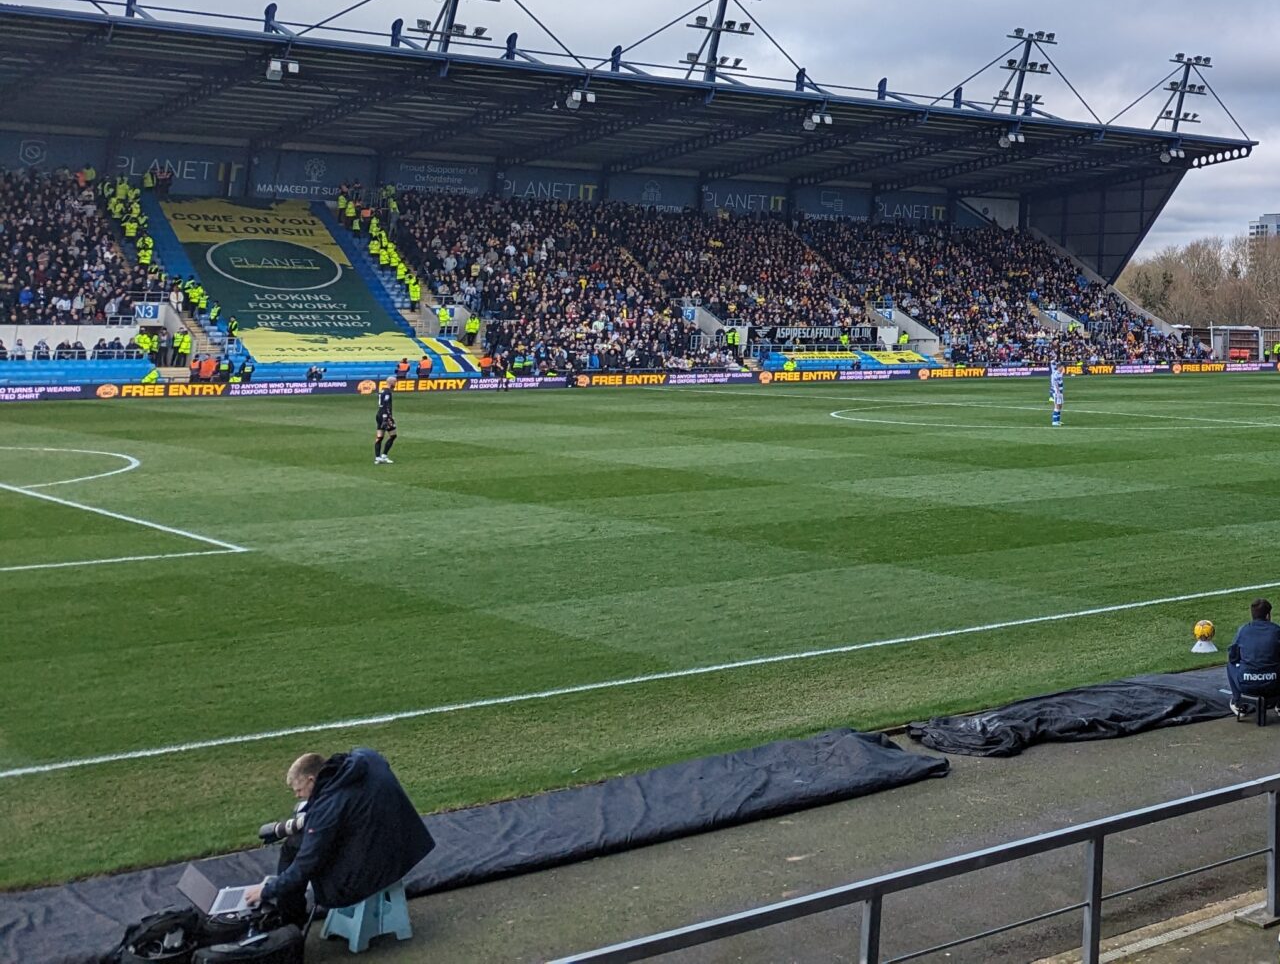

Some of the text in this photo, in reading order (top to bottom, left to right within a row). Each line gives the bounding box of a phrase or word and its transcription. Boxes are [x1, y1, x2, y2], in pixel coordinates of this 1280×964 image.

[256, 184, 308, 194] MANAGED
[310, 186, 319, 194] IT
[504, 180, 598, 201] PLANET IT
[704, 192, 786, 211] PLANET IT
[878, 202, 928, 220] PLANET
[932, 206, 946, 220] IT
[172, 212, 317, 226] COME ON YOU
[187, 224, 315, 236] YELLOWS!!!
[134, 305, 154, 318] N3
[286, 302, 348, 310] WORK?
[931, 369, 954, 378] FREE
[956, 368, 985, 378] ENTRY
[1066, 366, 1083, 374] FRE
[1182, 364, 1200, 372] FREE
[1202, 364, 1224, 372] ENTRY
[592, 374, 666, 386] FREE ENTRY
[774, 372, 801, 381] FREE
[802, 371, 838, 380] ENTRY
[121, 384, 166, 396] FREE
[168, 384, 226, 396] ENTRY
[418, 379, 467, 390] ENTRY
[1243, 672, 1277, 681] macron
